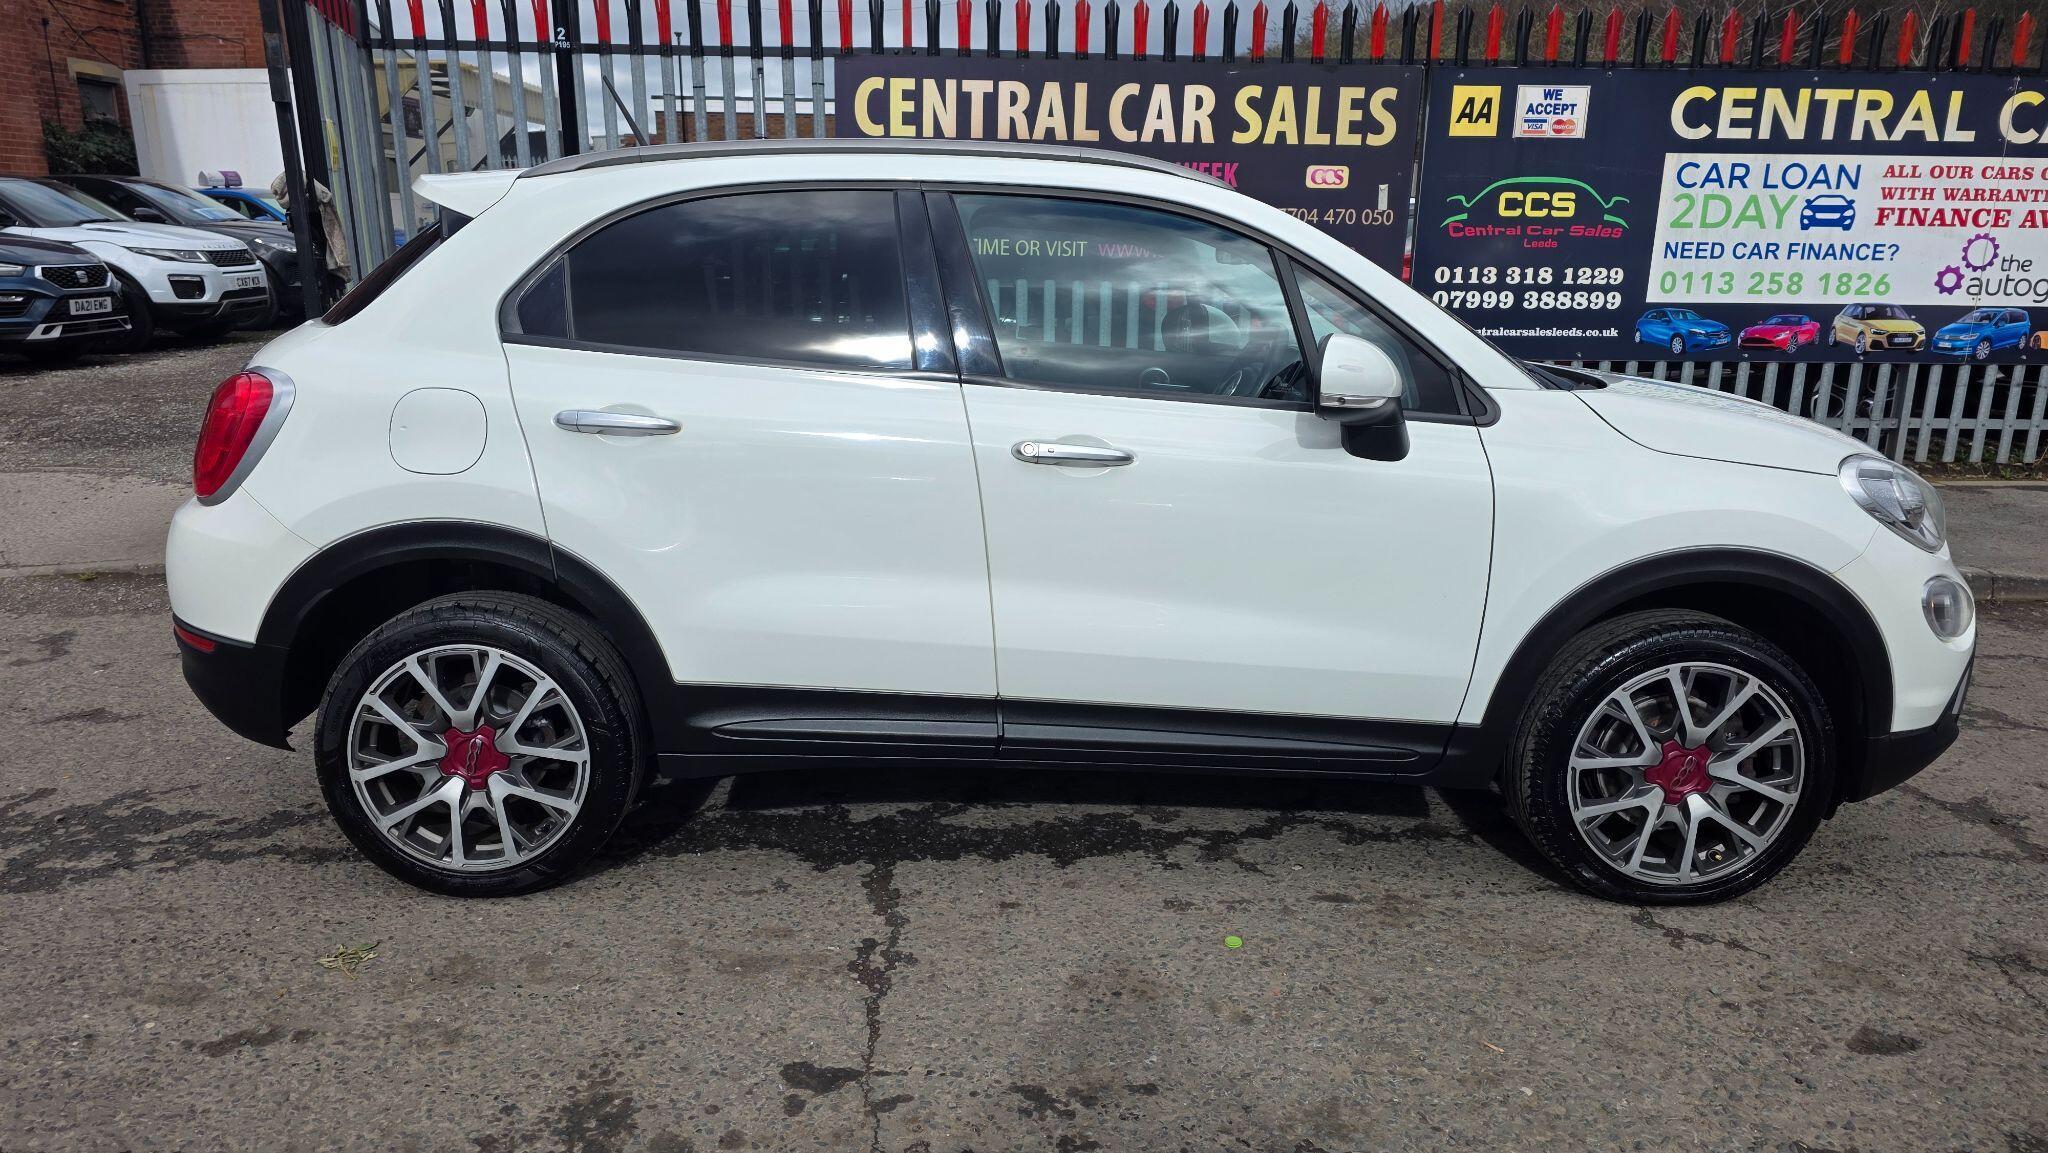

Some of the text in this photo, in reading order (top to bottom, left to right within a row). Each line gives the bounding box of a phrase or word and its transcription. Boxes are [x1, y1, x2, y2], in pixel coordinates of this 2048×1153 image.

[557, 27, 566, 39] 2
[1543, 89, 1564, 101] WE
[855, 77, 1398, 147] CENTRAL CAR SALES
[1455, 97, 1494, 124] AA
[1525, 103, 1577, 116] ACCEPT
[1670, 86, 1976, 141] CENTRAL
[1676, 162, 1862, 190] CAR LOAN
[1882, 165, 1922, 179] ALL
[1929, 165, 1974, 180] OUR
[1981, 166, 2035, 181] CARS
[1880, 187, 1936, 201] WITH
[1498, 191, 1576, 218] CCS
[1669, 192, 1799, 230] 2DAY
[1324, 208, 1357, 224] 470
[1362, 209, 1394, 225] 050
[1874, 207, 2012, 228] FINANCE
[1449, 222, 1623, 238] Central Car Sales
[1015, 239, 1040, 257] OR
[1046, 240, 1088, 257] VISIT
[1523, 238, 1558, 249] Leeds
[1663, 241, 1900, 262] NEED CAR FINANCE?
[2000, 254, 2033, 273] the
[1434, 266, 1625, 285] 0113 318 1229
[1659, 271, 1891, 296] 0113 258 1826
[1432, 290, 1622, 310] 07999 388899
